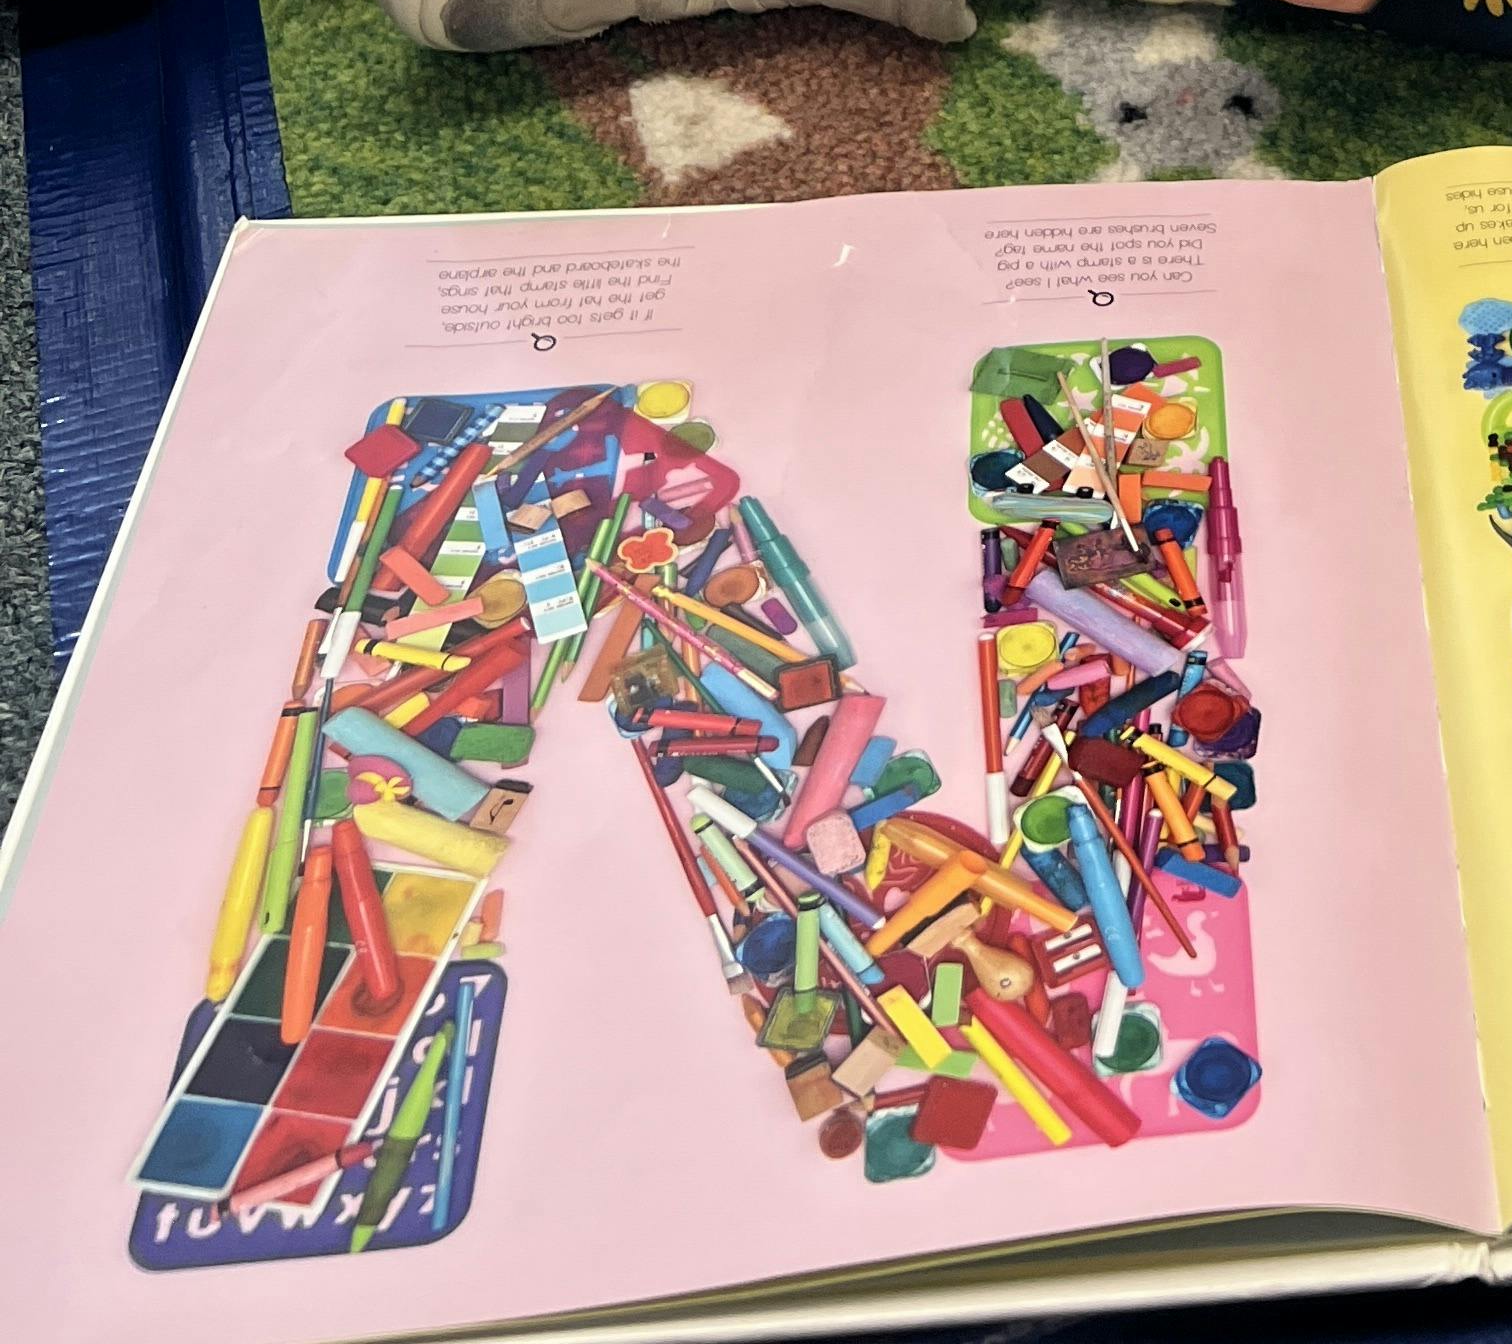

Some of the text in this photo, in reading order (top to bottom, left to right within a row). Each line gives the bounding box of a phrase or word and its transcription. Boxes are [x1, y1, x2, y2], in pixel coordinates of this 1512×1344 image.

[1446, 190, 1481, 202] hides
[1465, 204, 1483, 214] us,
[1491, 204, 1511, 214] for
[985, 223, 1216, 240] Seven brushes are hidden here
[1456, 221, 1473, 233] up
[995, 238, 1202, 256] Did you spot the name tag?
[1454, 238, 1488, 250] here
[439, 257, 681, 280] the skateboard and the airplane
[997, 255, 1204, 271] There is a stamp with a pig
[438, 274, 672, 298] Find the little stamp that sings,
[1006, 271, 1192, 289] Can you see what I see?
[441, 289, 666, 315] get the hat from your house
[442, 308, 654, 333] If it gets too bright outside,
